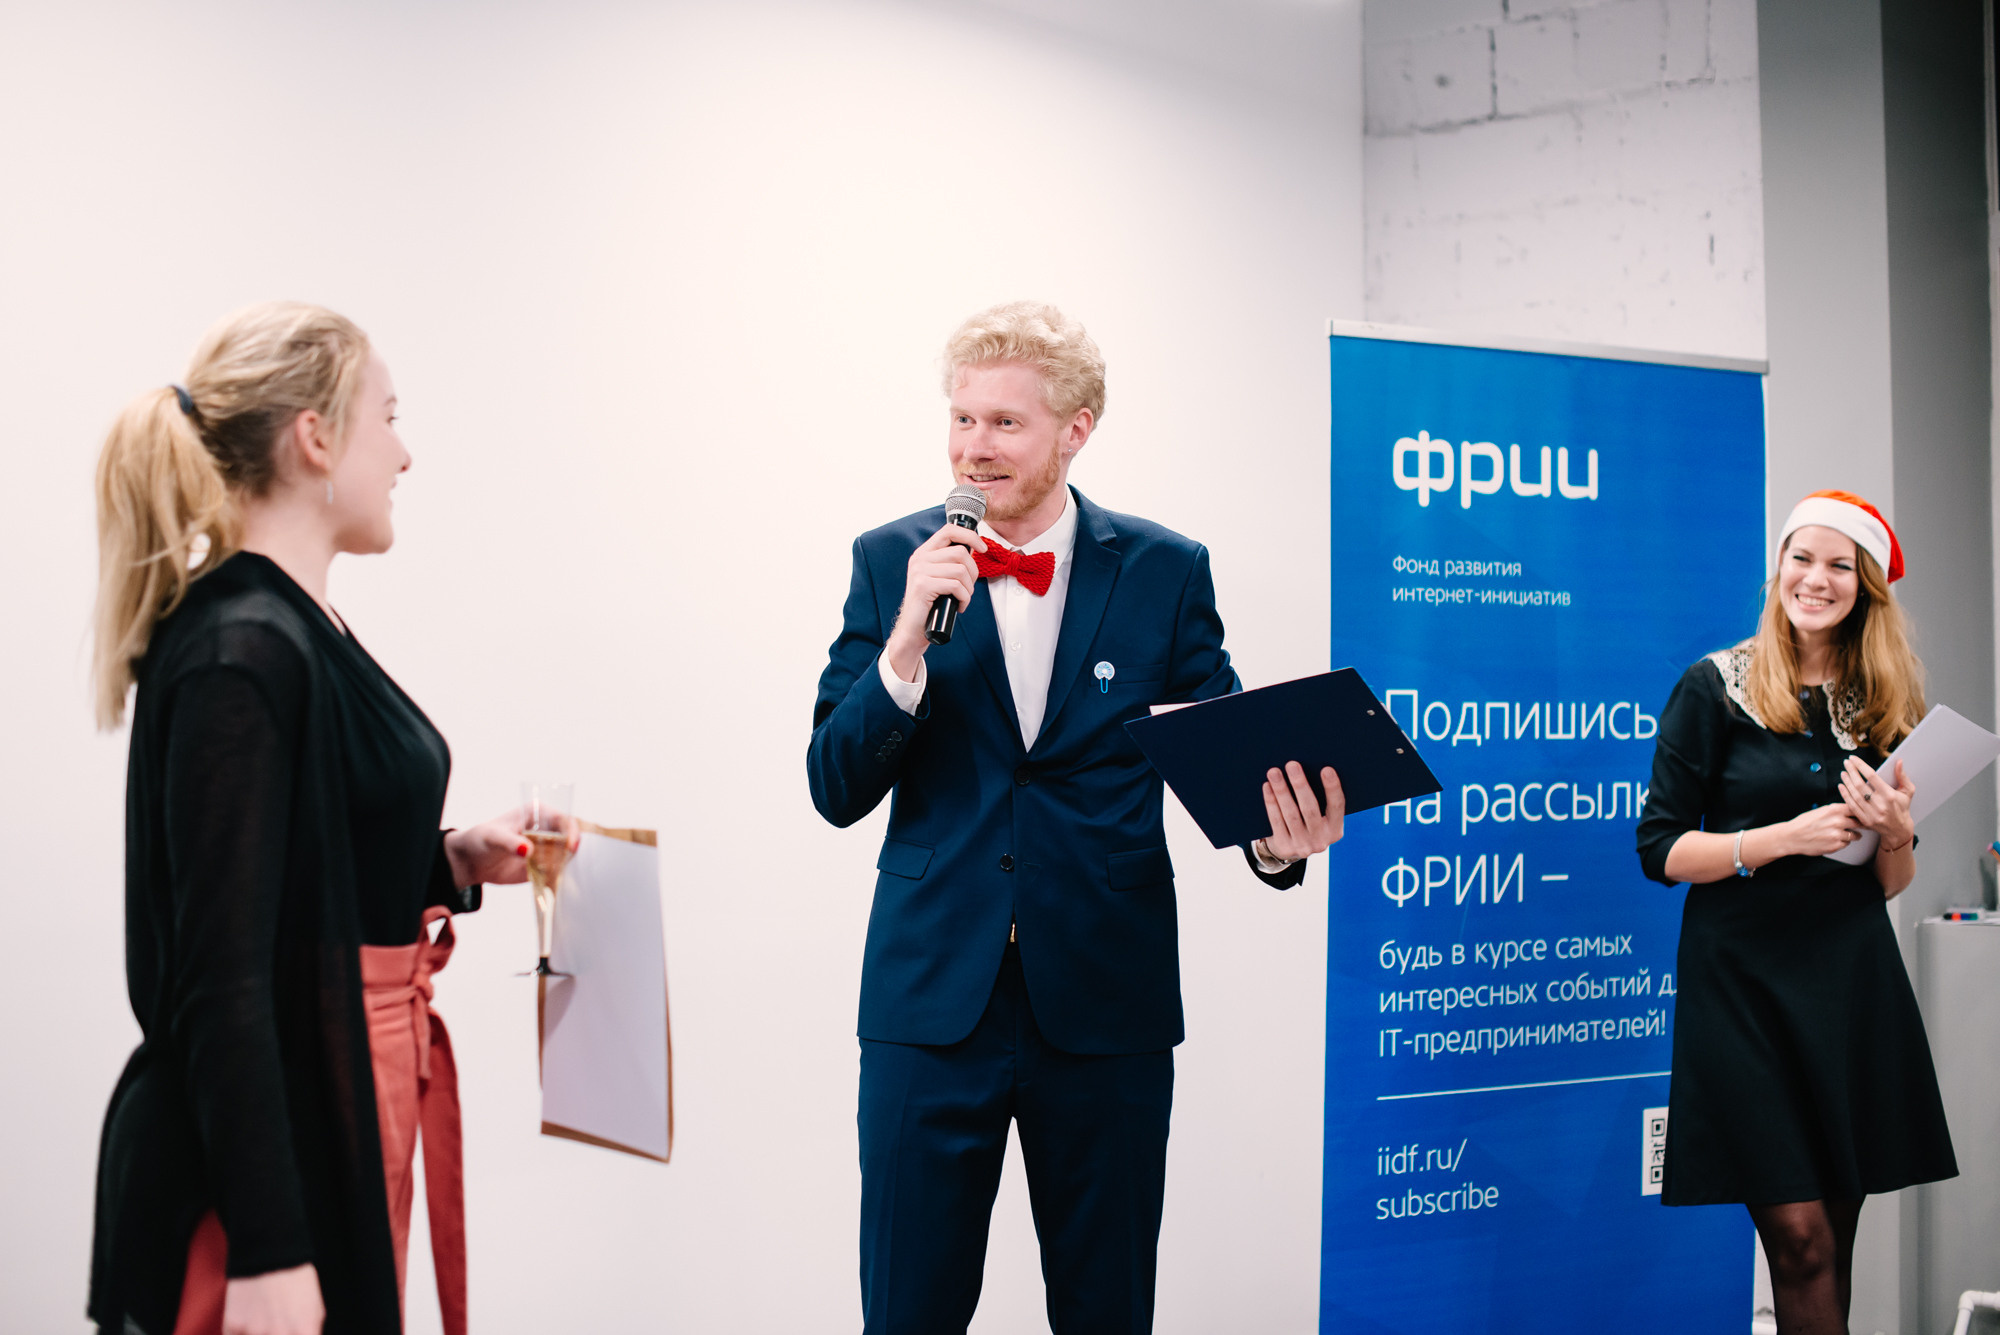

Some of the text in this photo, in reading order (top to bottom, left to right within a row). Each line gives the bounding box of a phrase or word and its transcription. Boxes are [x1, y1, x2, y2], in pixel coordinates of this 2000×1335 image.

[1392, 554, 1522, 578] Фонд развития
[1392, 587, 1571, 607] интернет-инициатив
[1385, 689, 1658, 747] Подпишись
[1461, 781, 1650, 836] рассылк
[1381, 853, 1524, 908] ФРИИ
[1379, 935, 1632, 975] будь в курсе самых
[1380, 983, 1537, 1015] интересных
[1546, 968, 1651, 1002] событий
[1380, 1009, 1666, 1060] IT-предпринимателей!
[1378, 1138, 1468, 1176] iidf.ru/
[1376, 1182, 1499, 1220] subscribe
